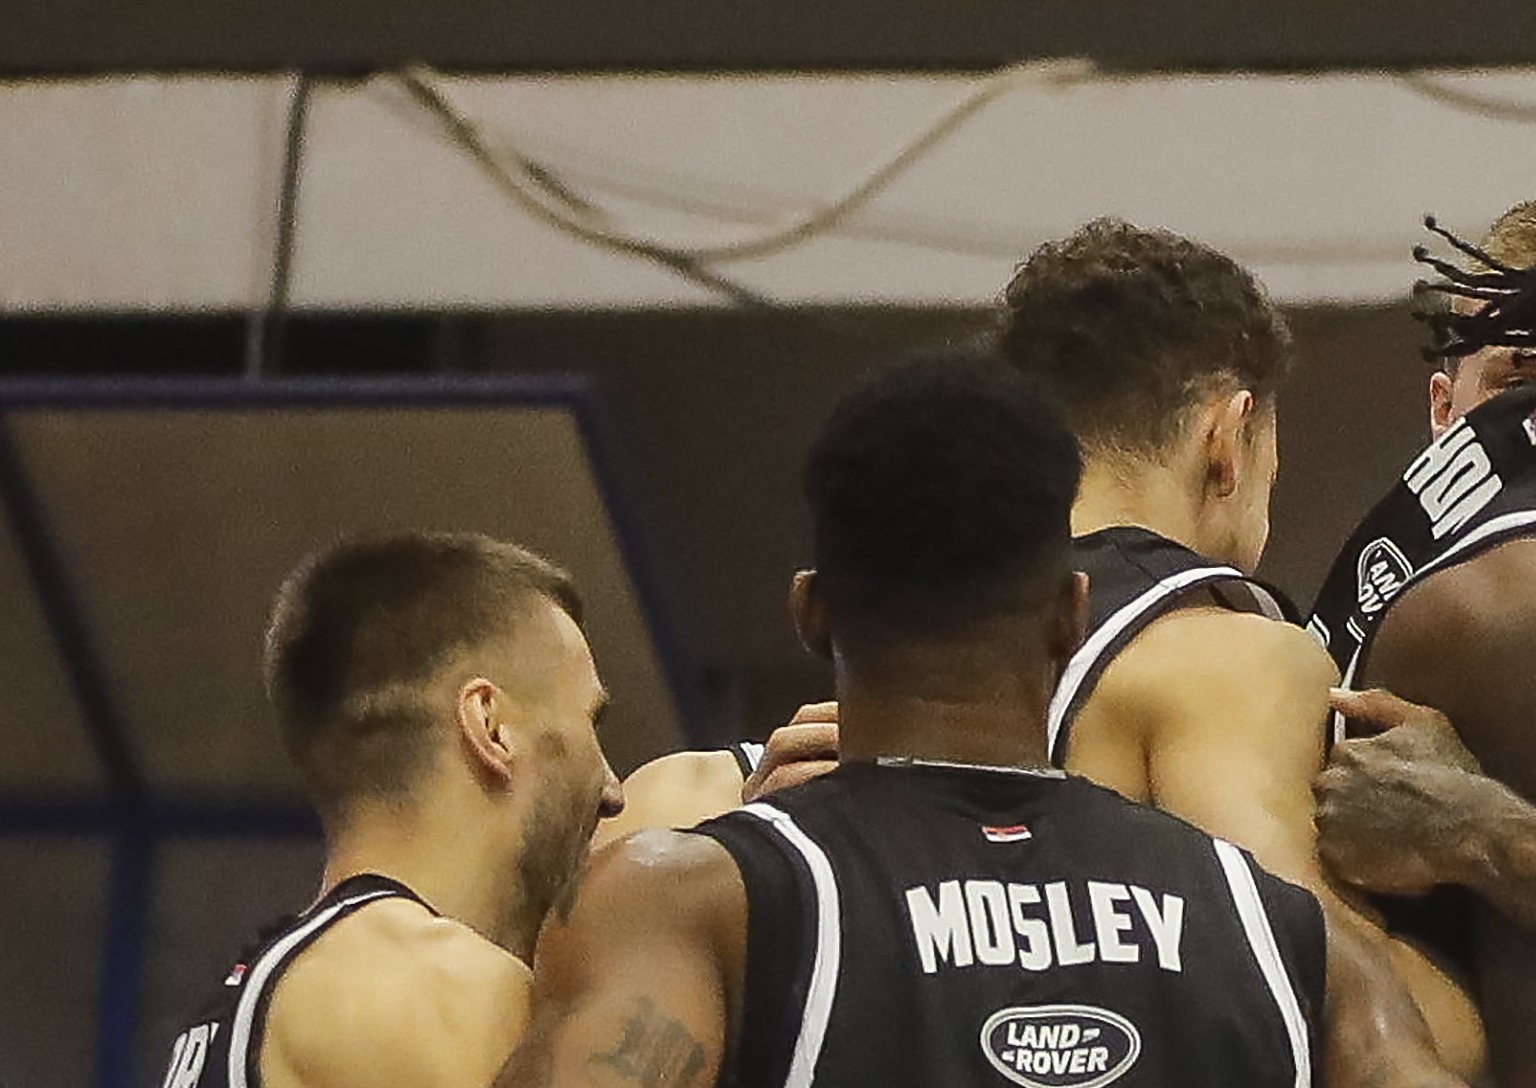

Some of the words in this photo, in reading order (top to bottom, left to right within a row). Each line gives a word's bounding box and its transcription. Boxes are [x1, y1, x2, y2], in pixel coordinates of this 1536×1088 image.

[905, 880, 1185, 974] MOSLEY
[1007, 1022, 1081, 1049] LAND
[1016, 1047, 1109, 1075] ROVER
